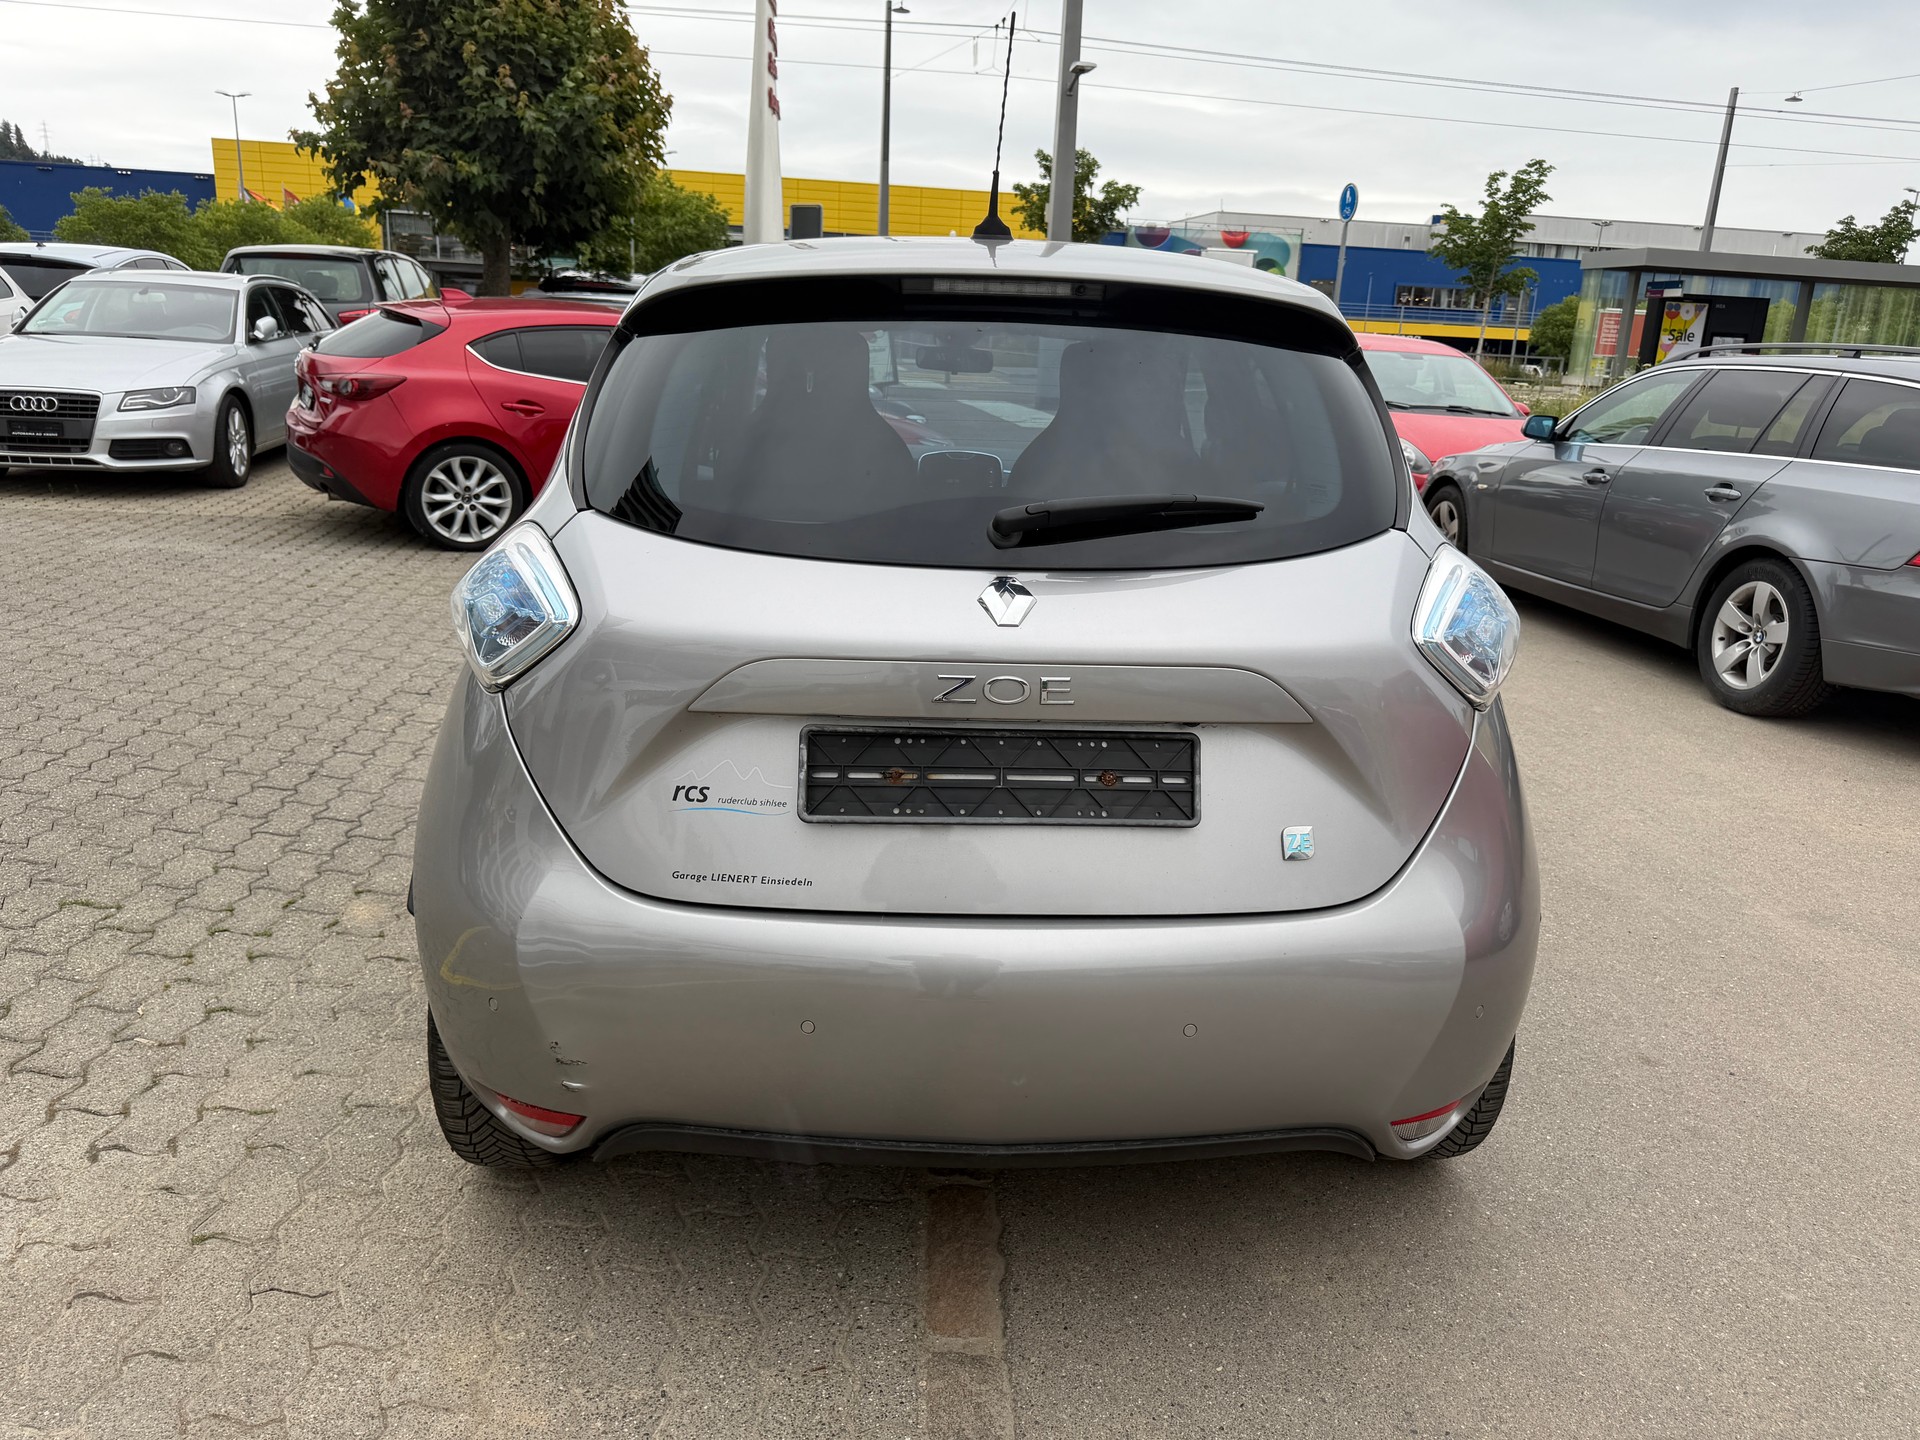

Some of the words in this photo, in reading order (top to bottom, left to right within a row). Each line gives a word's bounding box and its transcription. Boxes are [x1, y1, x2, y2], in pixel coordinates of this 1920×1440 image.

[1667, 328, 1695, 342] Sale
[932, 674, 1075, 705] ZOE
[672, 785, 710, 803] rcs
[717, 797, 758, 806] ruderclub
[759, 798, 788, 808] sihlsee
[671, 870, 708, 883] Garage
[710, 873, 758, 884] LIENERT
[760, 876, 813, 887] Einsiedeln
